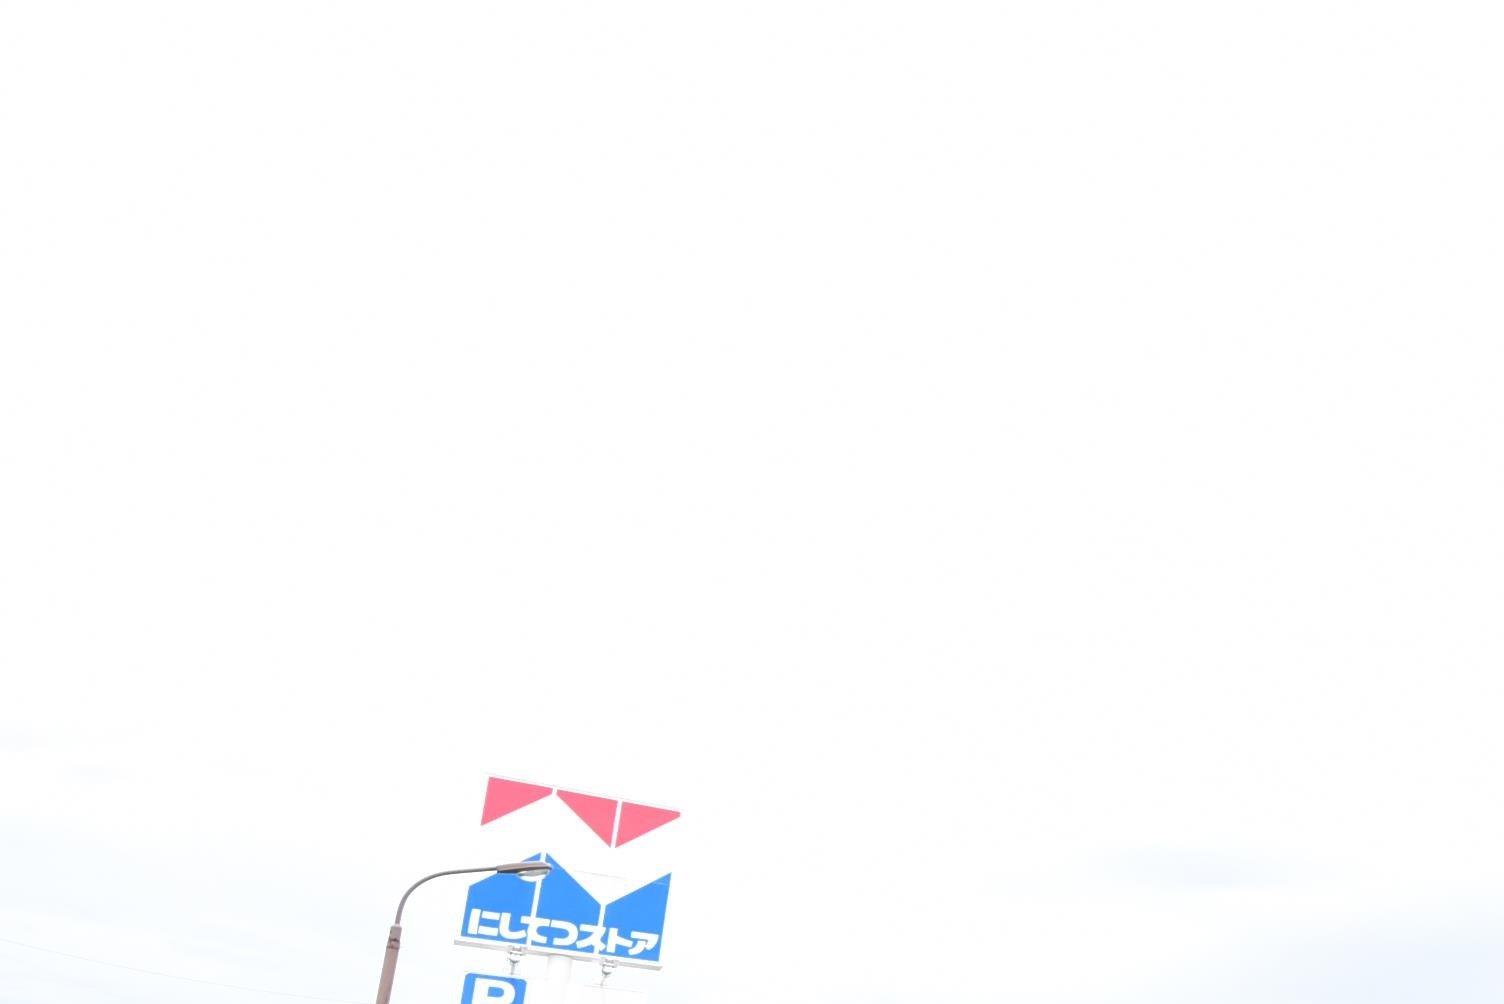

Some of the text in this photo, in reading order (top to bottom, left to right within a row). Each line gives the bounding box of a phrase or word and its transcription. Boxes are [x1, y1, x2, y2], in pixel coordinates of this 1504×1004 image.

[470, 908, 659, 954] にしてつストア
